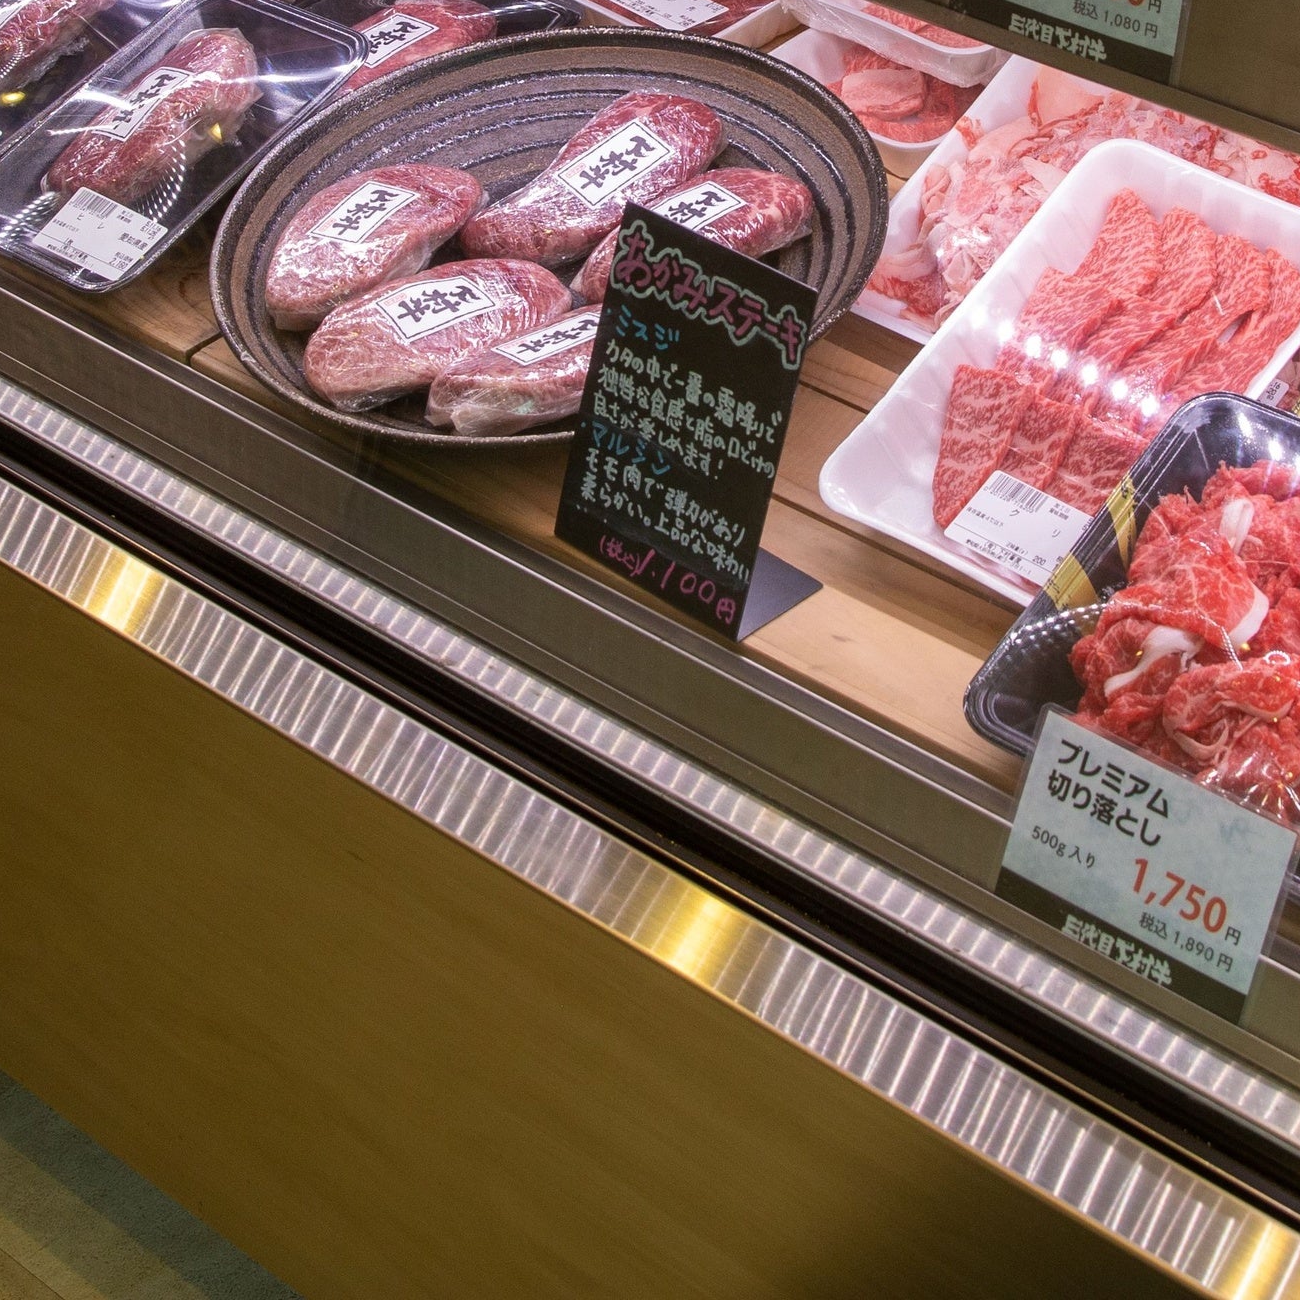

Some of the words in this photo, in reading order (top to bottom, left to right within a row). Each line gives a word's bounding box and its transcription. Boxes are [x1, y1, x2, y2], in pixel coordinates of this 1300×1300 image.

[366, 20, 421, 60] 下村
[1104, 9, 1141, 32] 1,080
[1145, 22, 1158, 39] 円
[578, 134, 656, 192] 下村牛
[331, 189, 400, 235] 下村牛
[667, 189, 728, 224] 下村
[397, 285, 482, 323] 下村牛
[615, 231, 801, 362] あかみステーキ
[1032, 555, 1046, 565] 200
[1057, 738, 1170, 819] プレミアム
[1047, 769, 1162, 848] 切り落とし
[1031, 824, 1067, 857] 500g
[1068, 846, 1097, 869] 入り
[1134, 857, 1228, 934] 1,750
[1224, 925, 1242, 947] 円
[1138, 910, 1169, 941] 税込
[1173, 930, 1214, 961] 1,890
[1217, 951, 1234, 973] 円
